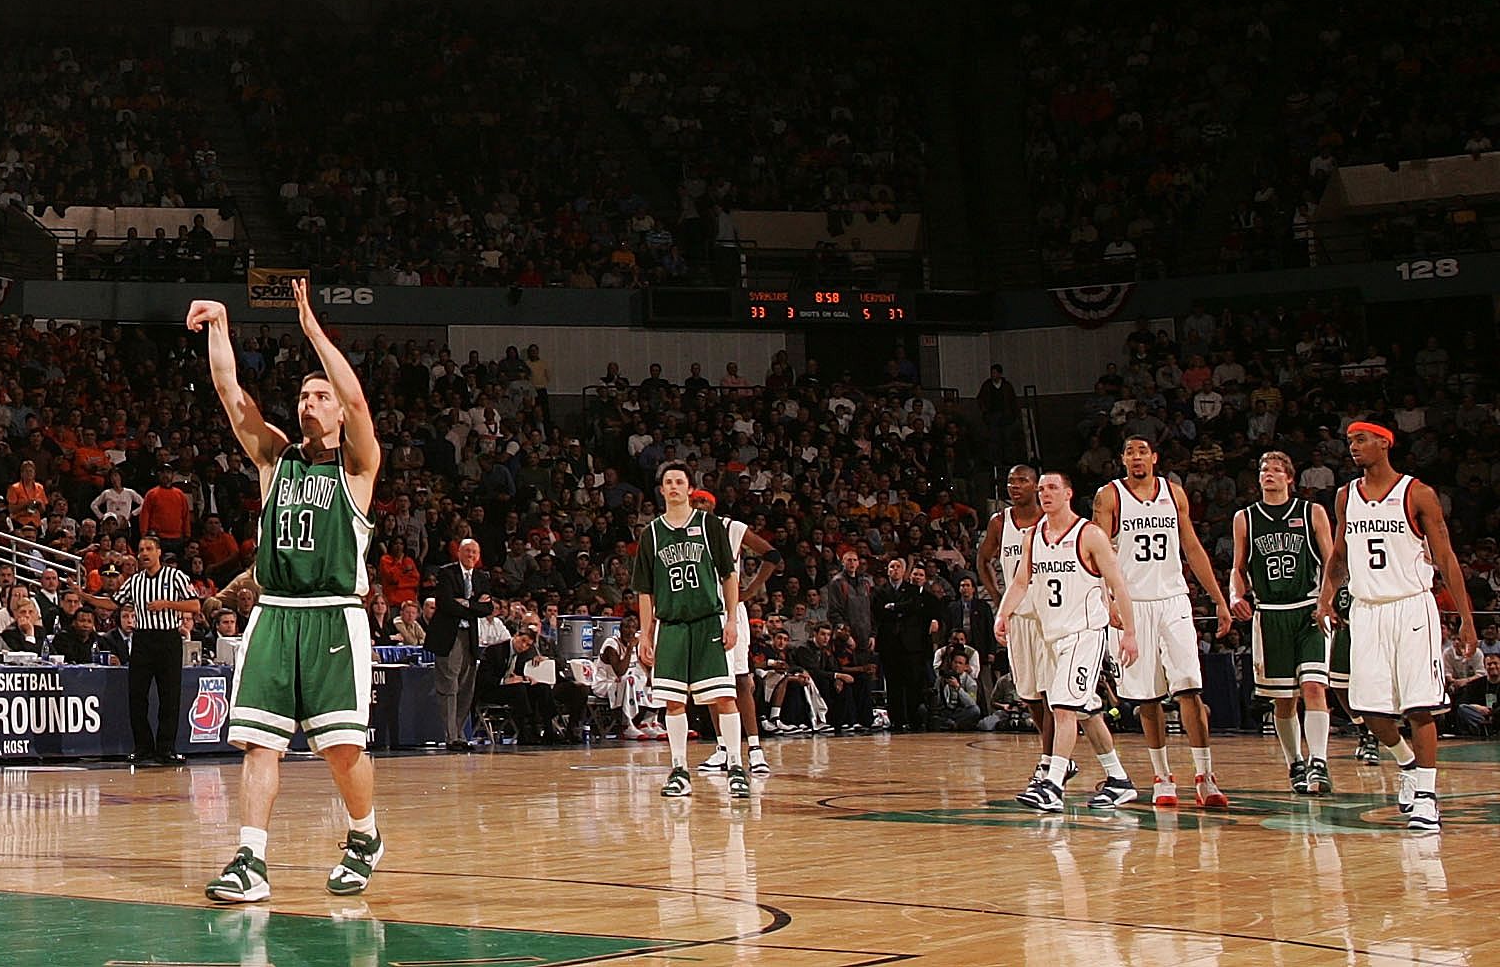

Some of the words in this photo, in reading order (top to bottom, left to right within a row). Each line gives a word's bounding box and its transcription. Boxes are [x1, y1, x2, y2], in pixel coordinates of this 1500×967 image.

[1396, 258, 1460, 281] 128
[319, 287, 374, 305] 126
[815, 291, 840, 304] 8:58
[751, 306, 766, 319] 33
[787, 306, 794, 319] 3
[863, 308, 871, 320] 5
[889, 308, 904, 320] 37
[276, 509, 315, 551] 11
[1122, 516, 1176, 532] SYRACUSE
[1347, 519, 1405, 535] SYRACUSE
[1134, 533, 1168, 562] 33
[1254, 532, 1305, 556] VERMONT
[658, 541, 705, 568] VERMONT
[1367, 538, 1387, 570] 5
[1032, 560, 1077, 574] SYRACUSE
[1266, 555, 1296, 581] 22
[669, 563, 700, 592] 24
[1047, 578, 1063, 608] 3
[200, 679, 225, 692] NCAA
[3, 739, 30, 755] HOST
